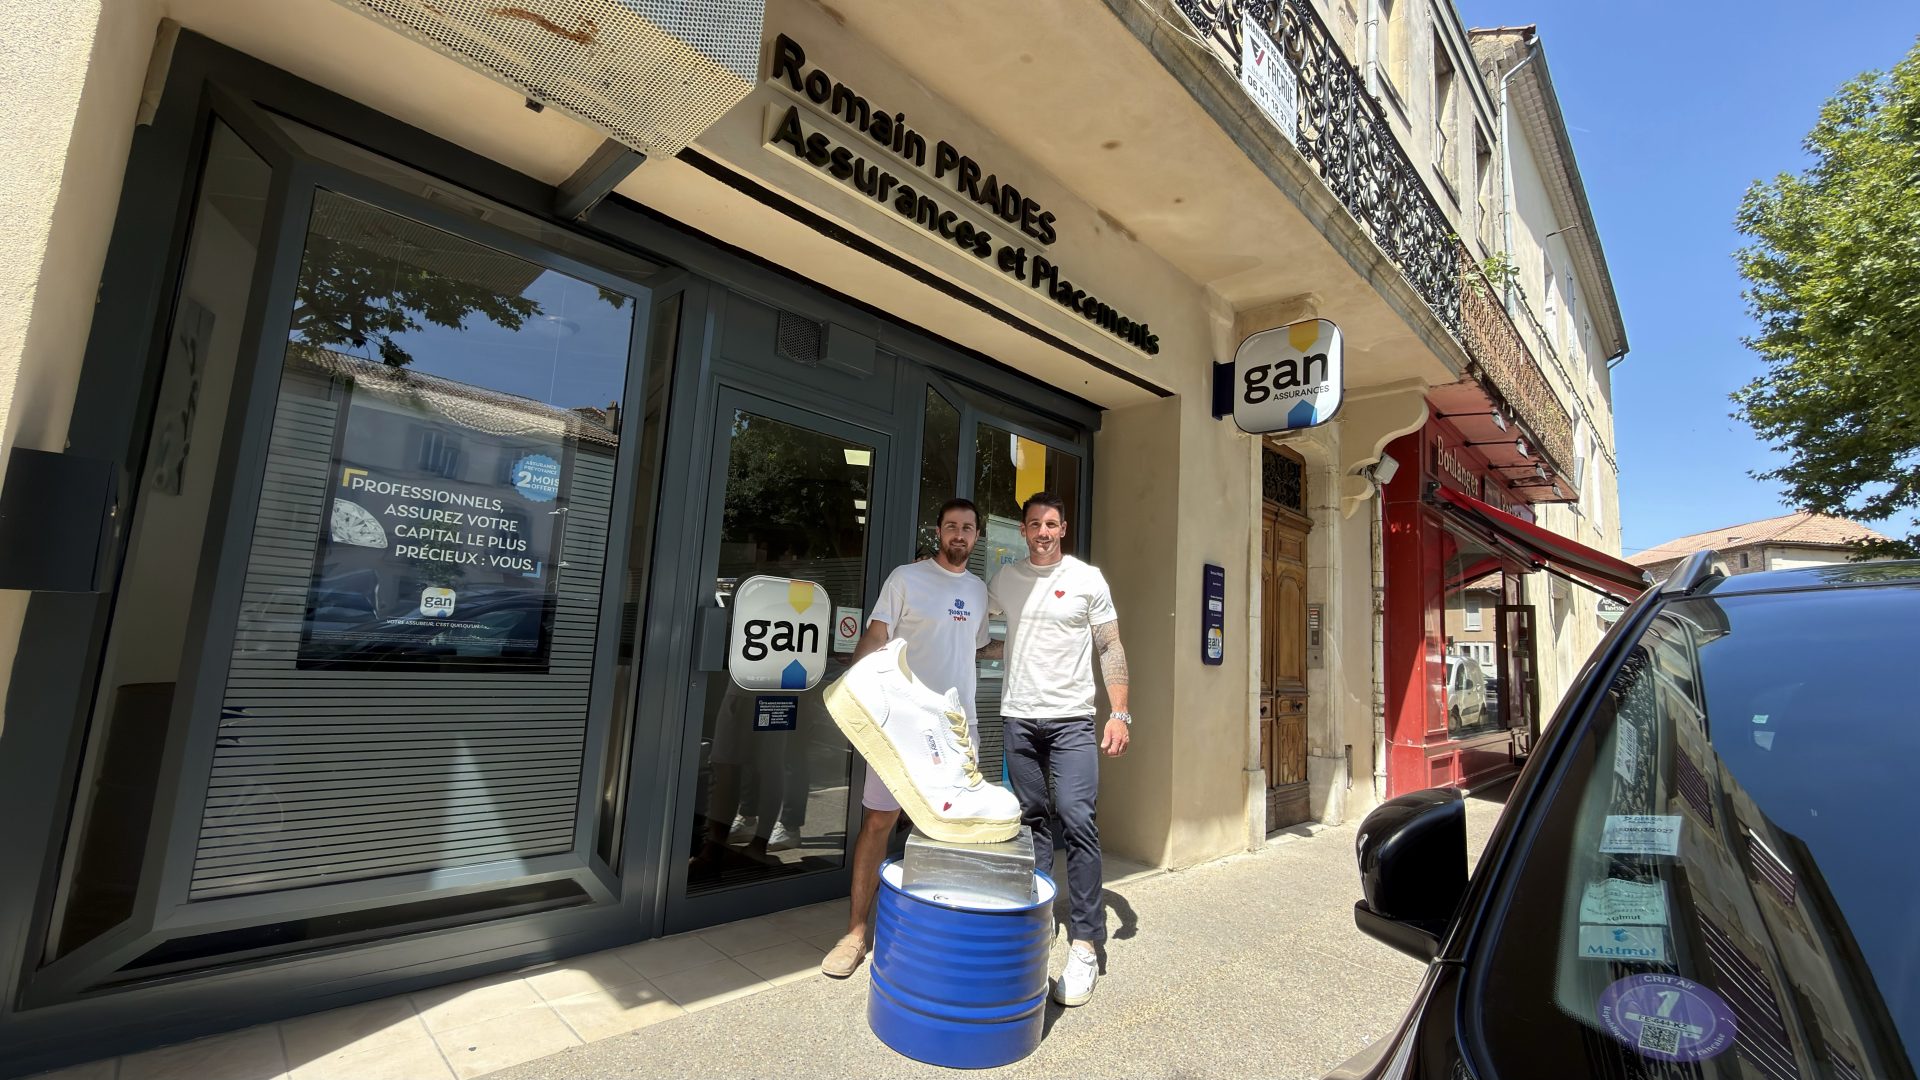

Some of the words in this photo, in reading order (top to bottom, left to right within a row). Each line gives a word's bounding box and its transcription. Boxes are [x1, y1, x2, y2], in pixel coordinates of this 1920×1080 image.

[1247, 75, 1258, 91] 06
[1260, 87, 1269, 103] 01
[1267, 56, 1294, 110] FAÇADE
[773, 32, 926, 167] Romain
[936, 139, 1058, 246] PRADES
[773, 105, 993, 260] Assurances
[998, 245, 1028, 281] et
[1031, 258, 1160, 356] Placements
[1244, 353, 1328, 404] gan
[1273, 385, 1330, 401] ASSURANCES
[517, 471, 531, 488] 2
[532, 475, 559, 487] MOIS
[1437, 434, 1478, 498] Boulanger
[352, 477, 504, 514] PROFESSIONNELS,
[384, 504, 464, 525] ASSUREZ
[467, 514, 519, 532] VOTRE
[394, 524, 463, 544] CAPITAL
[467, 533, 485, 547] LE
[487, 536, 527, 551] PLUS
[395, 544, 478, 565] PRÉCIEUX
[481, 557, 486, 566] :
[489, 554, 534, 571] VOUS.
[424, 596, 452, 608] gan
[742, 619, 819, 662] gan
[1587, 944, 1657, 956] Matmut
[1643, 975, 1696, 990] CRIT'Air
[1656, 990, 1681, 1018] 1
